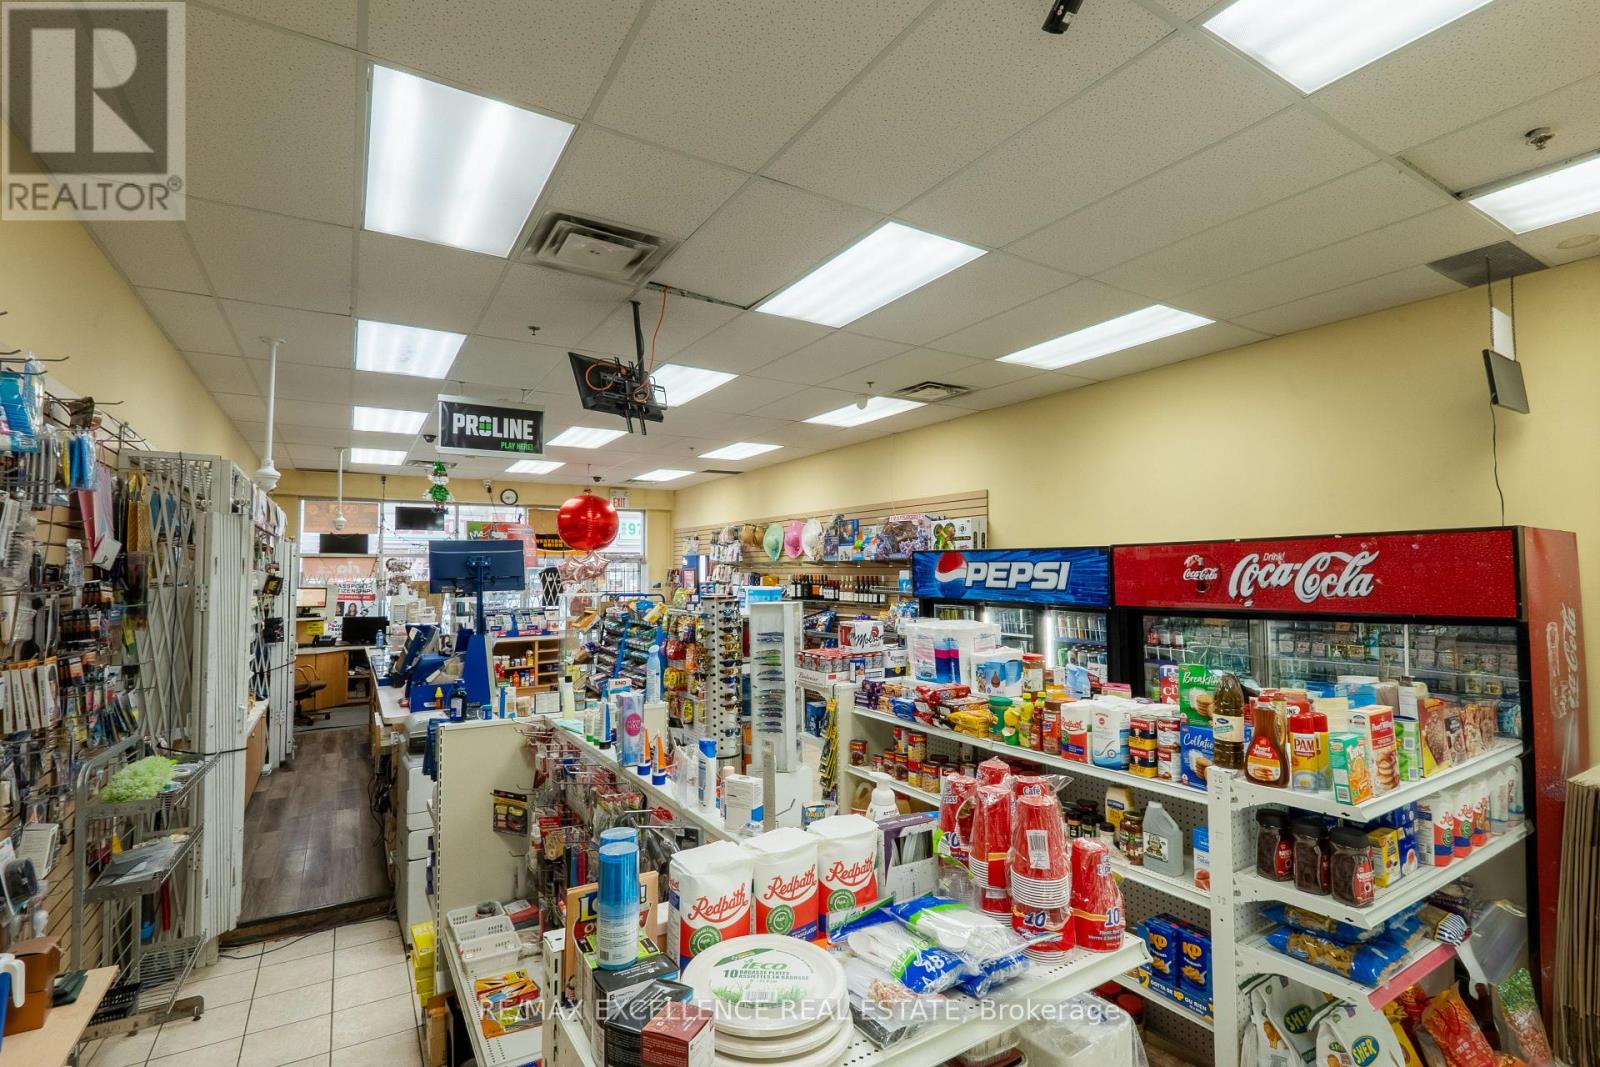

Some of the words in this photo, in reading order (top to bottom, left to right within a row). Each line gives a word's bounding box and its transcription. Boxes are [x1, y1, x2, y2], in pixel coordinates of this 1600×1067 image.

[452, 412, 533, 440] PROLINE
[500, 442, 515, 450] PLAY
[516, 443, 533, 451] HERE!
[613, 497, 626, 508] EXIT
[965, 561, 1070, 591] PEPSI
[1229, 551, 1380, 602] Coca-Cola
[1294, 738, 1315, 752] PAM
[1023, 786, 1041, 796] Café
[825, 852, 874, 887] Redpath
[763, 864, 819, 901] Redpath
[688, 883, 750, 922] Redpath
[1024, 912, 1047, 928] 10
[1106, 907, 1120, 926] 10
[923, 955, 945, 972] 48
[723, 969, 739, 979] 10
[1352, 1039, 1376, 1064] SHER
